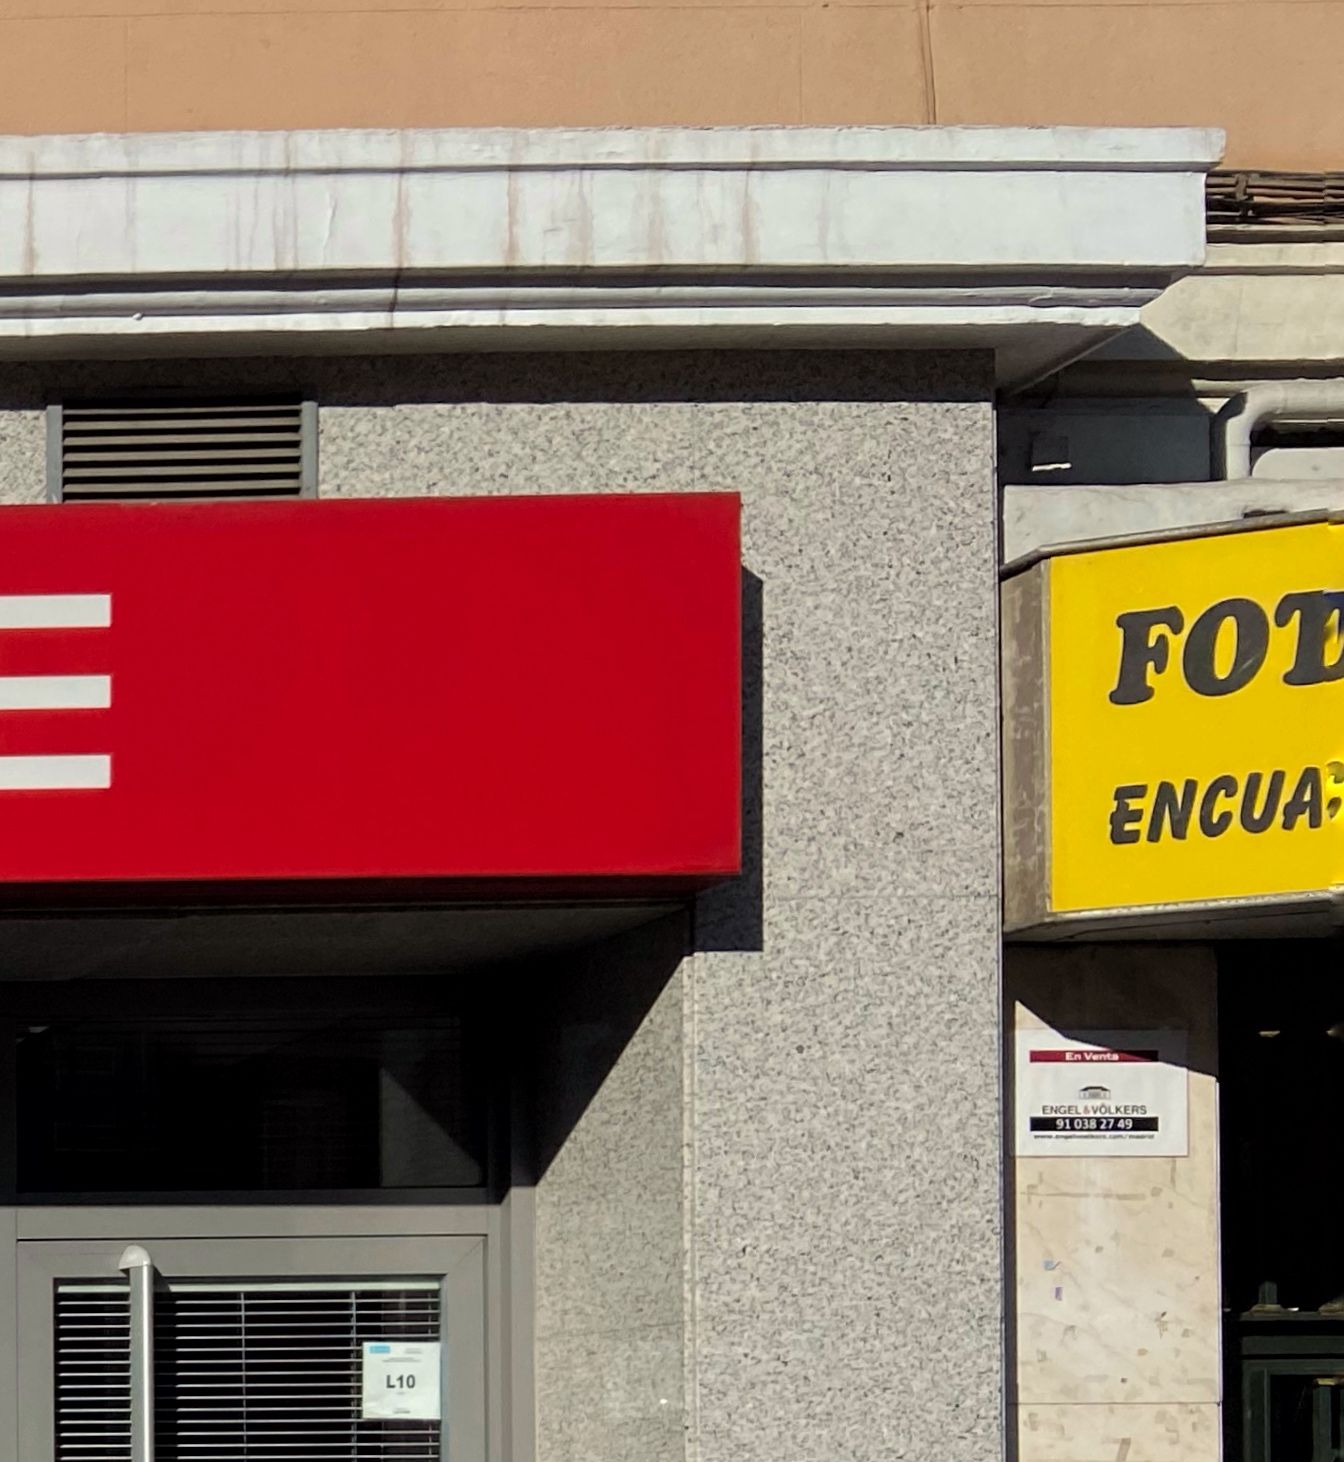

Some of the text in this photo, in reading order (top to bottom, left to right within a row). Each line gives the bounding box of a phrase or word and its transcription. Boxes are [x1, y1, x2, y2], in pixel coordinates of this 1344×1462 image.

[1110, 760, 1344, 845] ENCUA
[1065, 1052, 1119, 1061] En Venta
[1055, 1119, 1133, 1130] 91 038 27 49
[386, 1374, 416, 1389] L10
